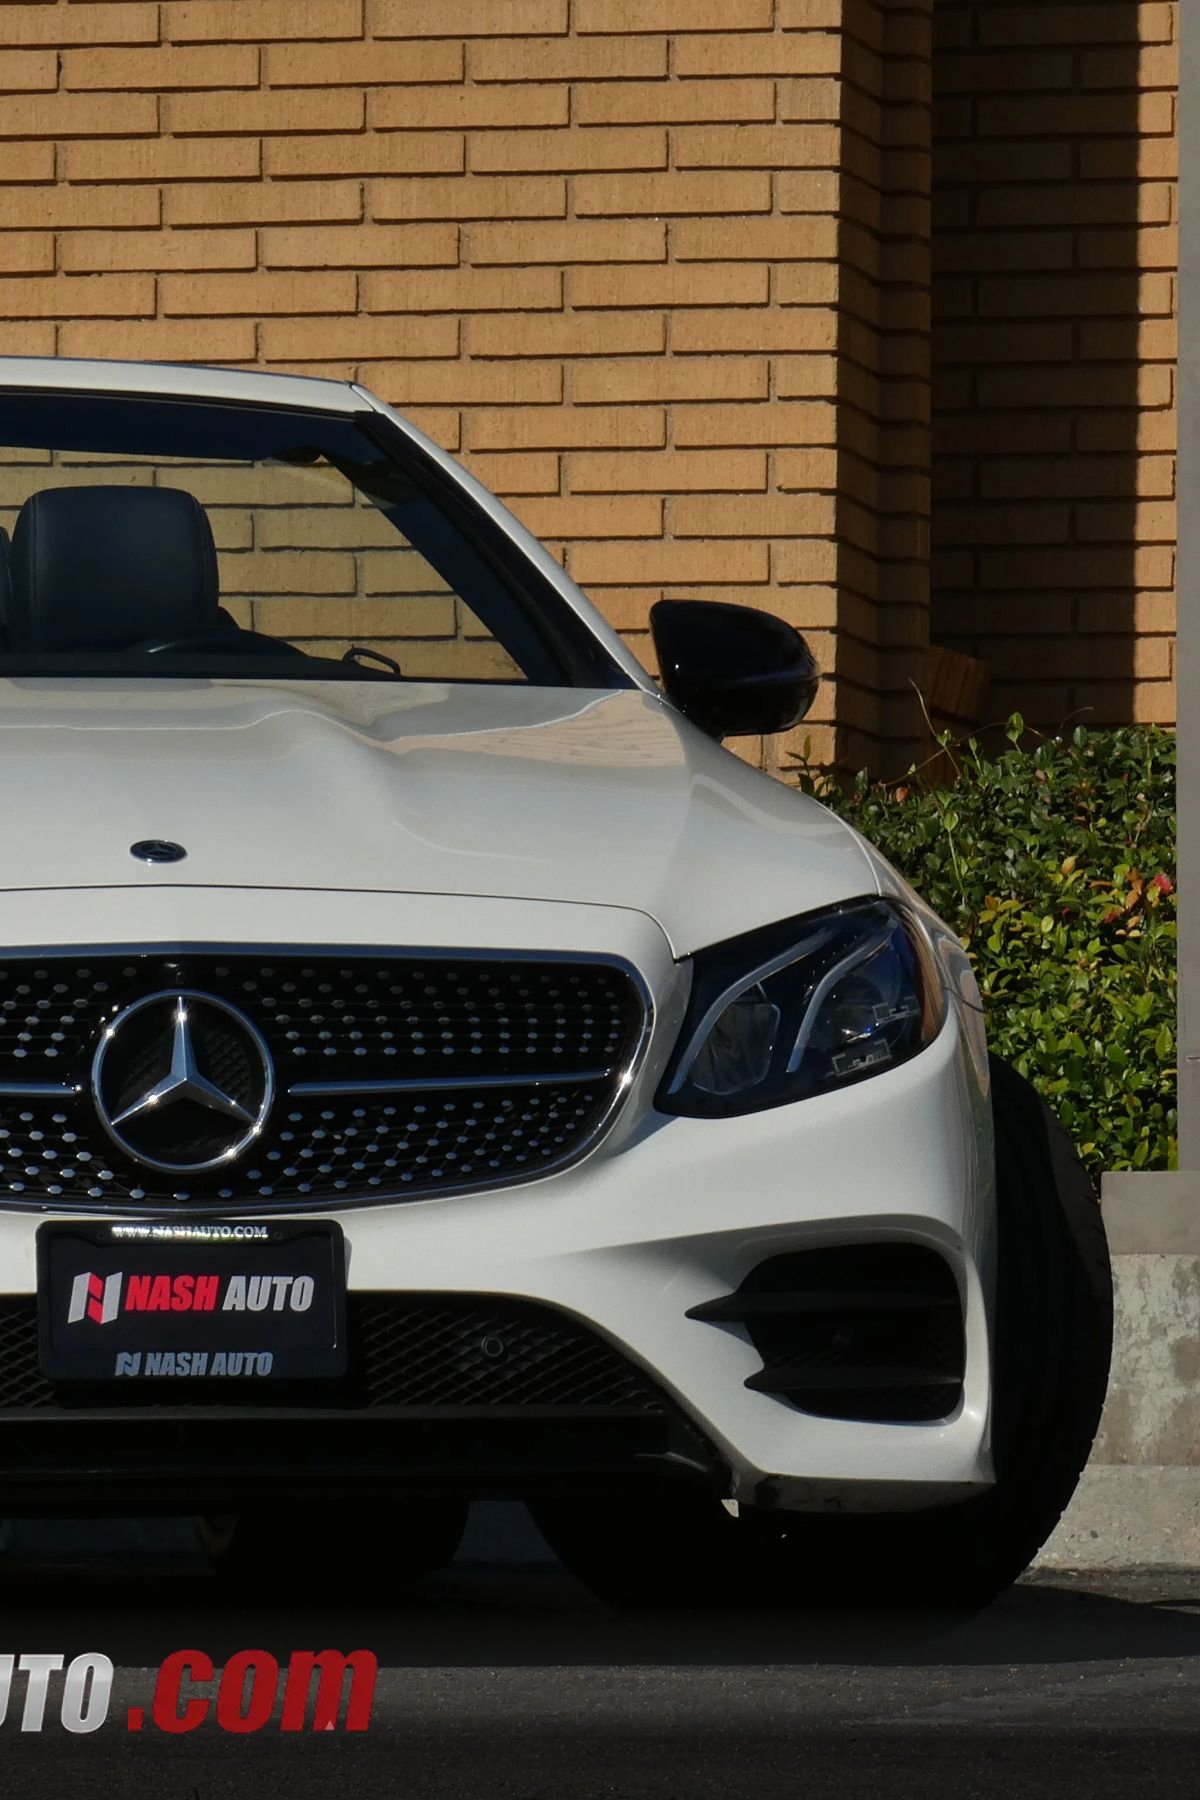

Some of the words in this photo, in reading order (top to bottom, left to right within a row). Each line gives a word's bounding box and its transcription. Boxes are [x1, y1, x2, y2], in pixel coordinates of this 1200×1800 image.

[125, 1275, 219, 1312] NASH
[222, 1275, 315, 1312] AUTO
[144, 1352, 210, 1377] NASH
[210, 1352, 274, 1377] AUTO
